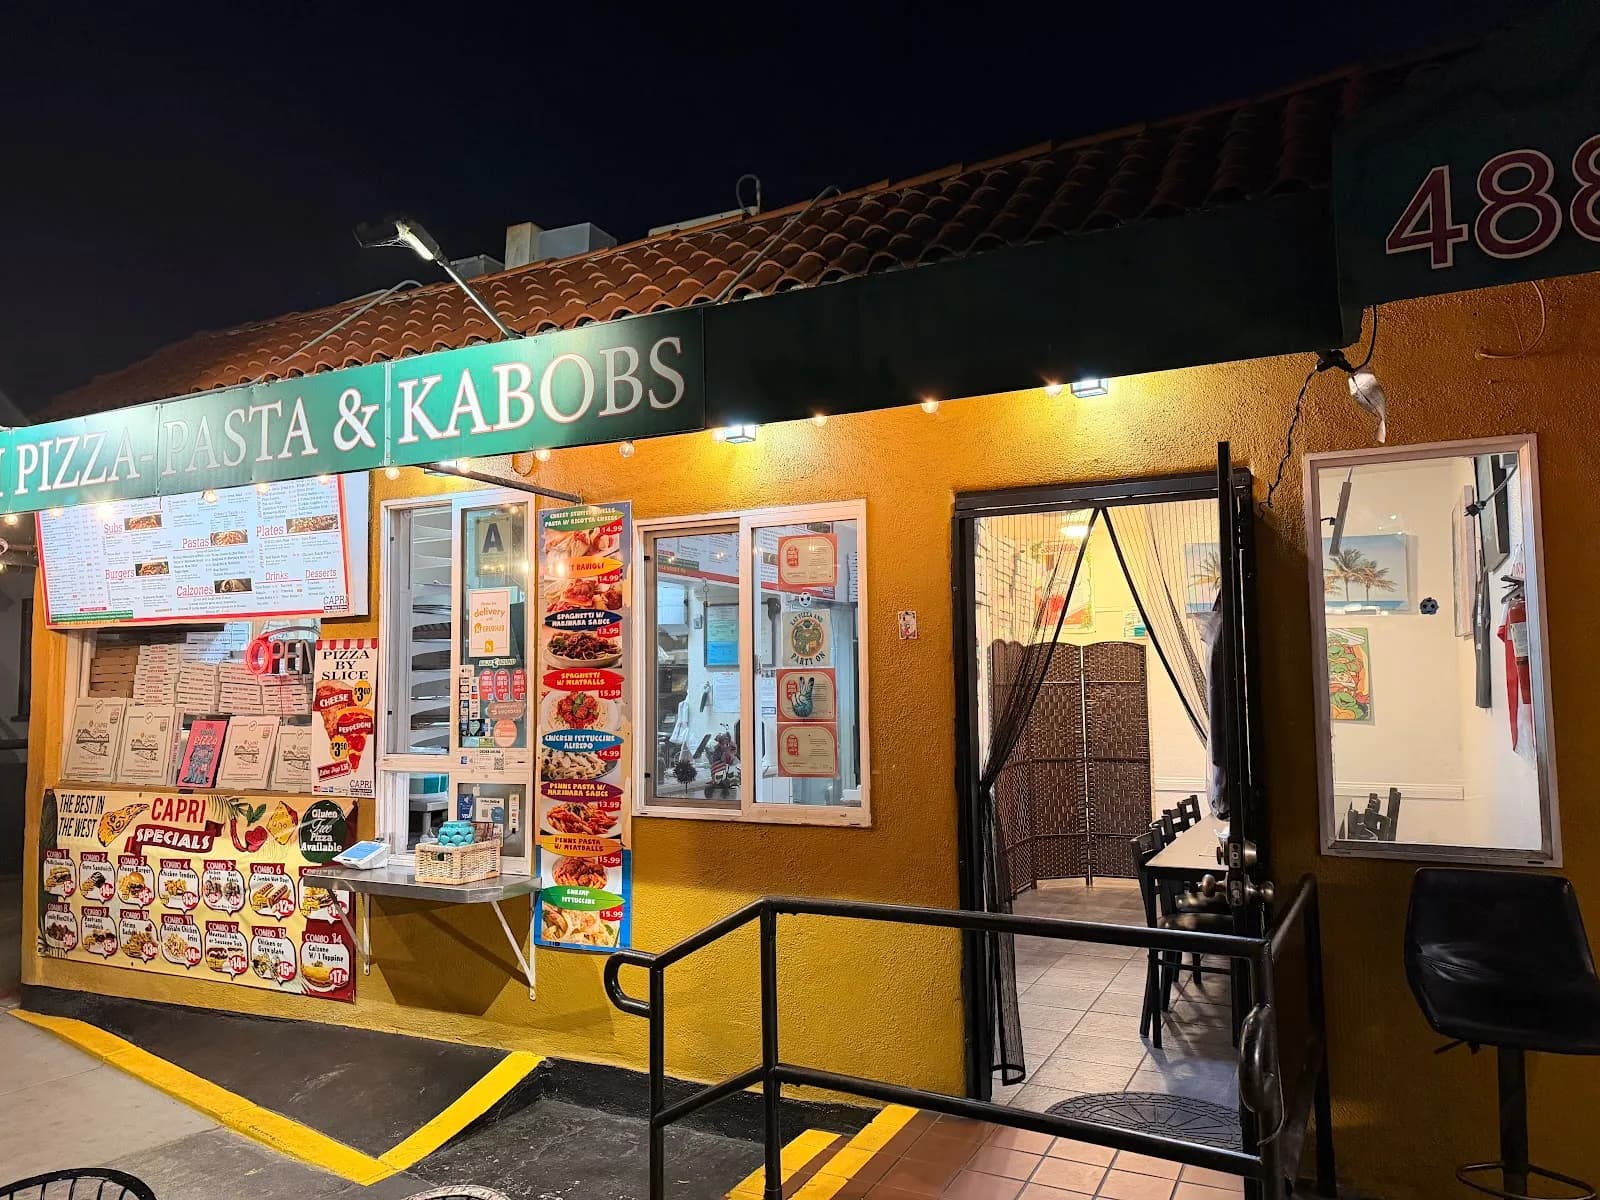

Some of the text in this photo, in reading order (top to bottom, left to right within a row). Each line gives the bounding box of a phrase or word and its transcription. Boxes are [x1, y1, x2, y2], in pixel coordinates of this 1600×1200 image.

[333, 387, 380, 452] &
[398, 336, 686, 444] KABOBS
[103, 523, 123, 534] Subs
[256, 525, 284, 537] Plates
[602, 525, 623, 533] 14.99
[482, 522, 504, 553] A
[182, 537, 210, 549] Pastas
[105, 568, 135, 581] Burgers
[265, 571, 289, 581] Drinks
[305, 568, 337, 579] Desserts
[176, 584, 214, 597] Calzones
[474, 608, 505, 618] delivery
[556, 612, 595, 620] SPAGHETTI
[246, 638, 312, 675] OPEN
[323, 650, 370, 660] PIZZA
[335, 660, 357, 671] BY
[321, 671, 369, 681] SLICE
[566, 678, 605, 686] MEATBALLS
[319, 693, 349, 708] CHEESE
[338, 722, 372, 735] PEPPERONI
[350, 779, 373, 789] CAPRI
[60, 794, 106, 814] THE BEST IN
[151, 797, 206, 824] CAPRI
[312, 808, 338, 819] Gluten
[58, 817, 97, 838] THE WEST
[310, 818, 333, 835] Free
[136, 827, 210, 850] SPECIALS
[310, 832, 333, 843] Pizza
[301, 842, 343, 852] Available
[62, 849, 67, 859] 1
[83, 853, 105, 861] COMBO 2
[120, 856, 145, 866] COMBO 3
[162, 860, 188, 869] COMBO 4
[599, 856, 621, 864] 15.99
[93, 864, 112, 872] Sandwich
[206, 861, 233, 871] COMBO 5
[253, 865, 281, 875] COMBO 6
[47, 903, 63, 912] COMBO
[83, 907, 107, 917] COMBO 9
[122, 910, 149, 920] COMBO 10
[163, 915, 193, 925] COMBO 11
[208, 922, 237, 933] COMBO 12
[254, 927, 286, 938] COMBO 13
[233, 939, 243, 947] Sub
[257, 938, 276, 947] Chicken
[305, 933, 342, 944] COMBO 14
[308, 944, 329, 953] Calzone
[322, 953, 344, 963] Topping
